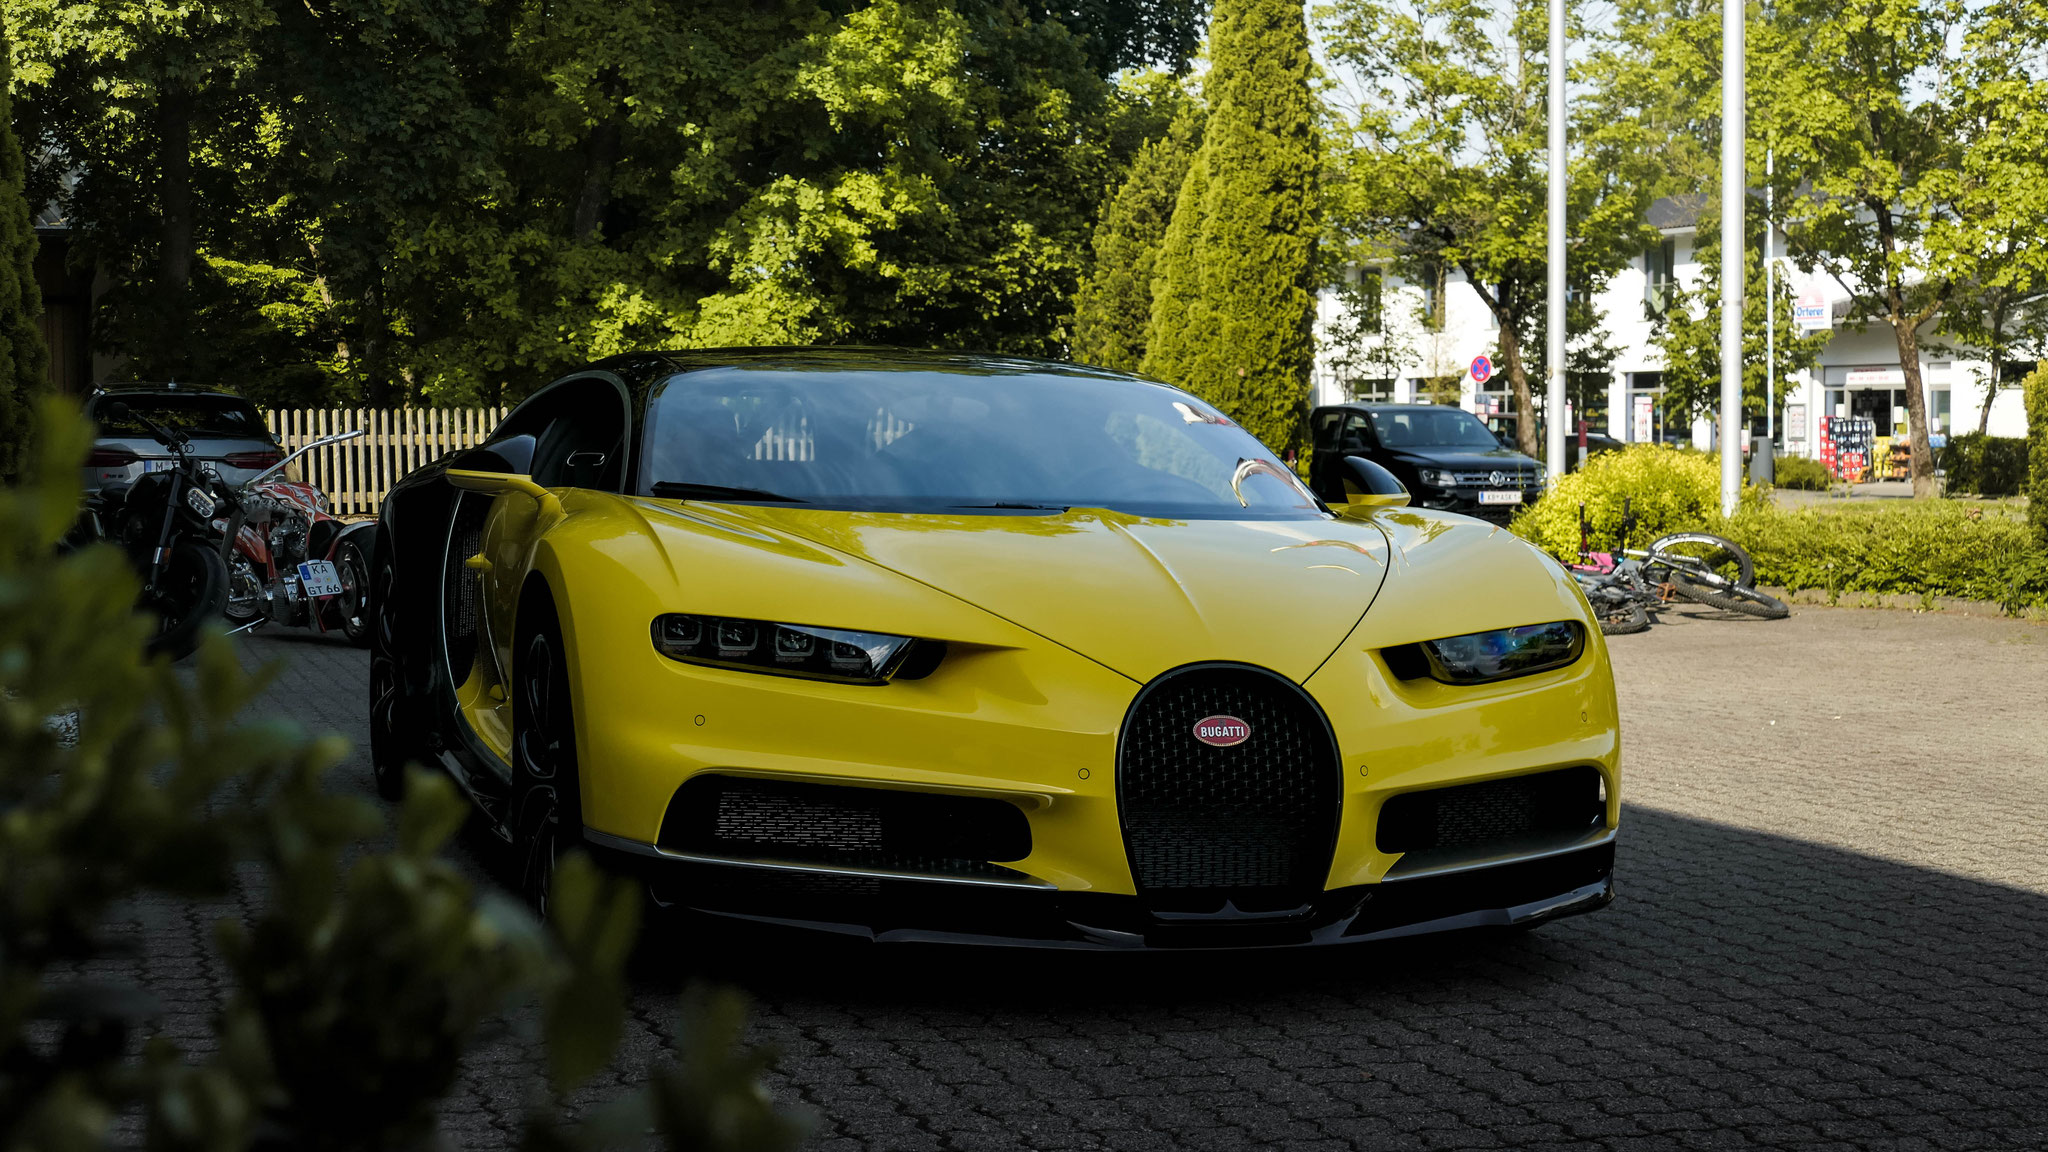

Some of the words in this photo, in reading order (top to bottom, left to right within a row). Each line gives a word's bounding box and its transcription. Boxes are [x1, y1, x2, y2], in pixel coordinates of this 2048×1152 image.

[1796, 306, 1824, 317] Orterer
[311, 565, 328, 574] KA
[308, 586, 322, 595] GT
[327, 584, 340, 593] 66
[1200, 726, 1245, 737] BUGATTI
